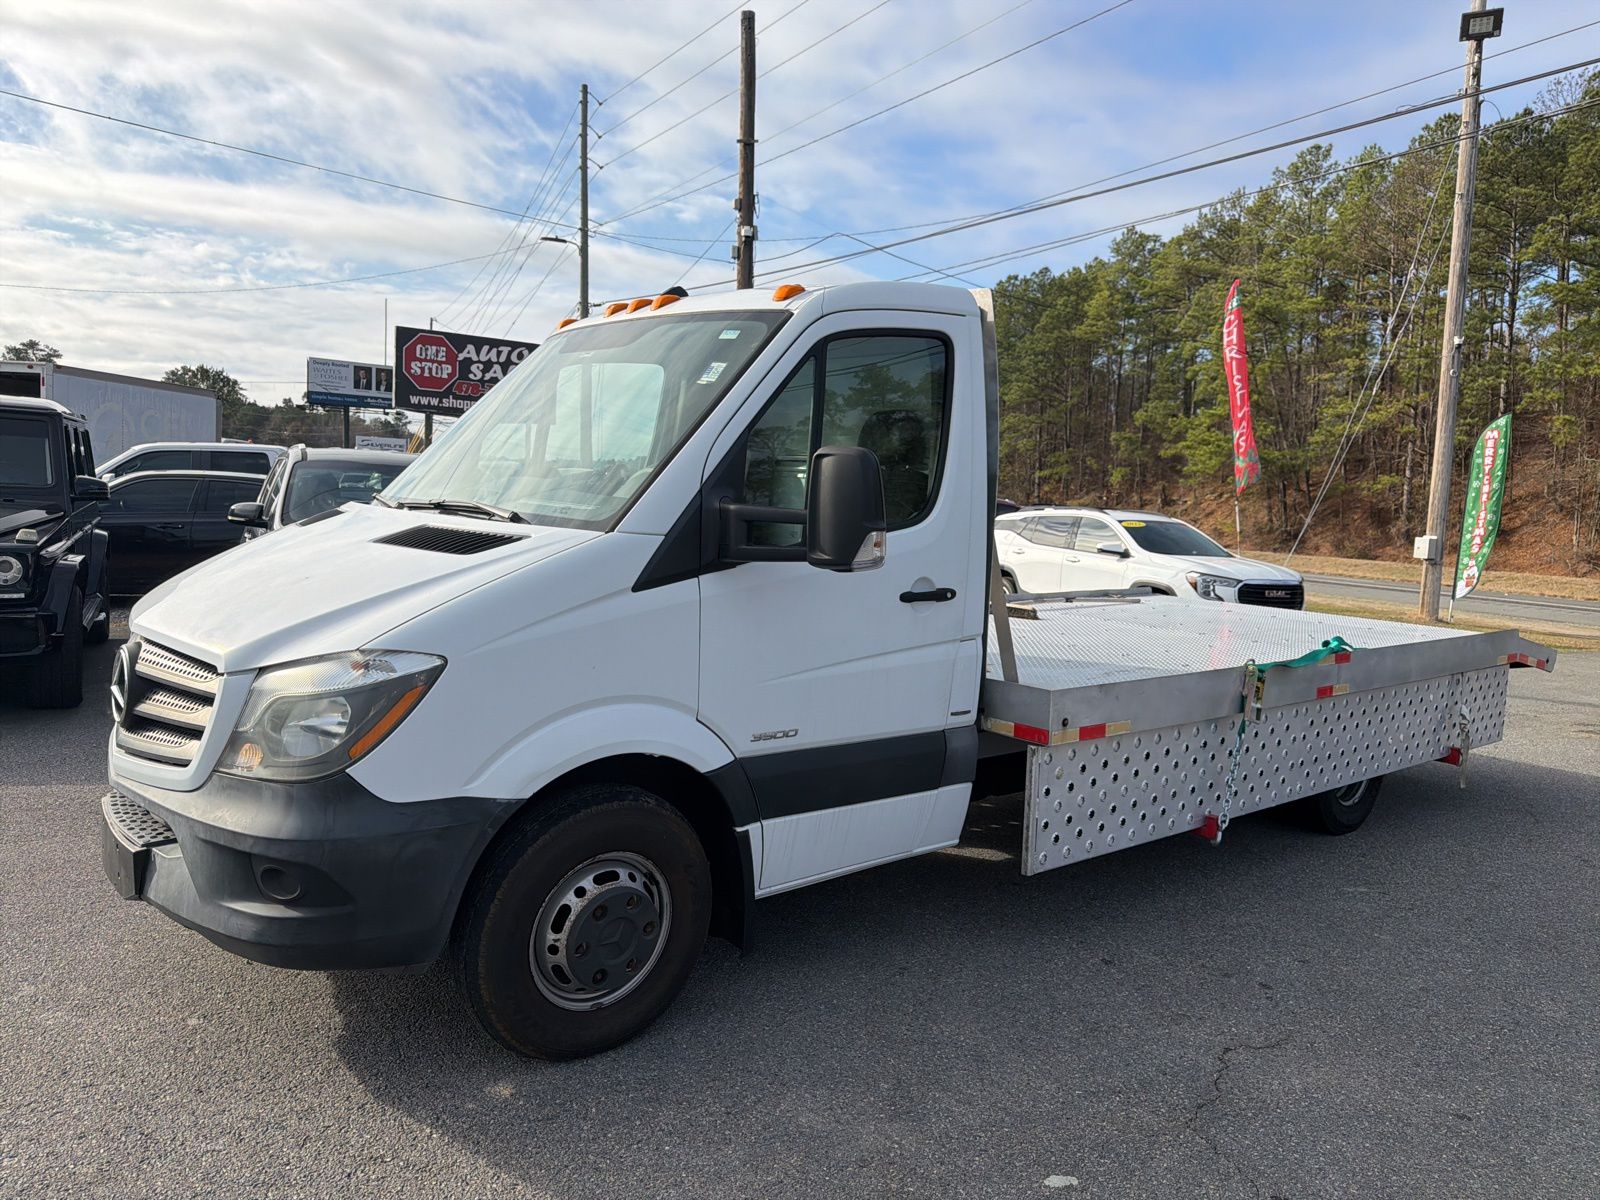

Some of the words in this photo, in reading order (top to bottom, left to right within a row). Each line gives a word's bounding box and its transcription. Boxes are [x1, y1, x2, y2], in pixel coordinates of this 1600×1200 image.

[415, 344, 447, 361] ONE
[457, 343, 529, 364] AUTO
[410, 361, 452, 379] STOP
[1484, 429, 1499, 475] MERRY
[1472, 475, 1490, 554] CHRISTMAS
[1265, 590, 1291, 598] GMC
[750, 728, 799, 742] 3500
